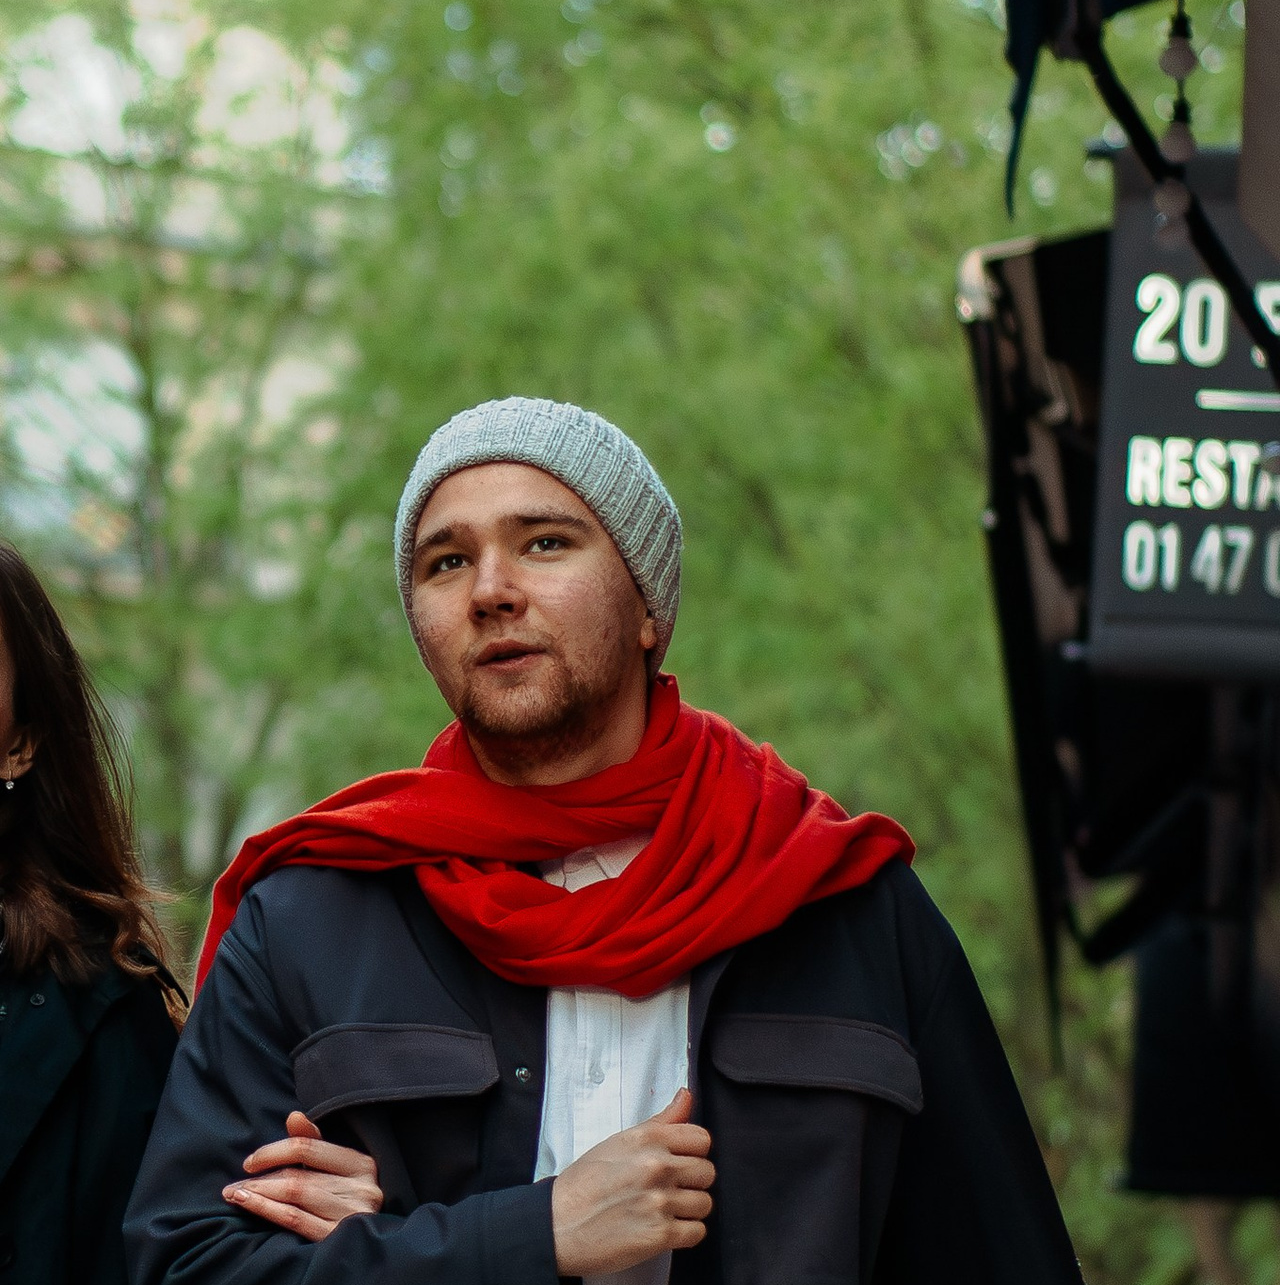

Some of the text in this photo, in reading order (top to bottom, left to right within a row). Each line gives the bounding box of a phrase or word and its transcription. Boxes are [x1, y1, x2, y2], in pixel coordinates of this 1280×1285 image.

[1133, 273, 1229, 367] 20
[1123, 520, 1180, 592] 01
[1190, 524, 1254, 595] 47
